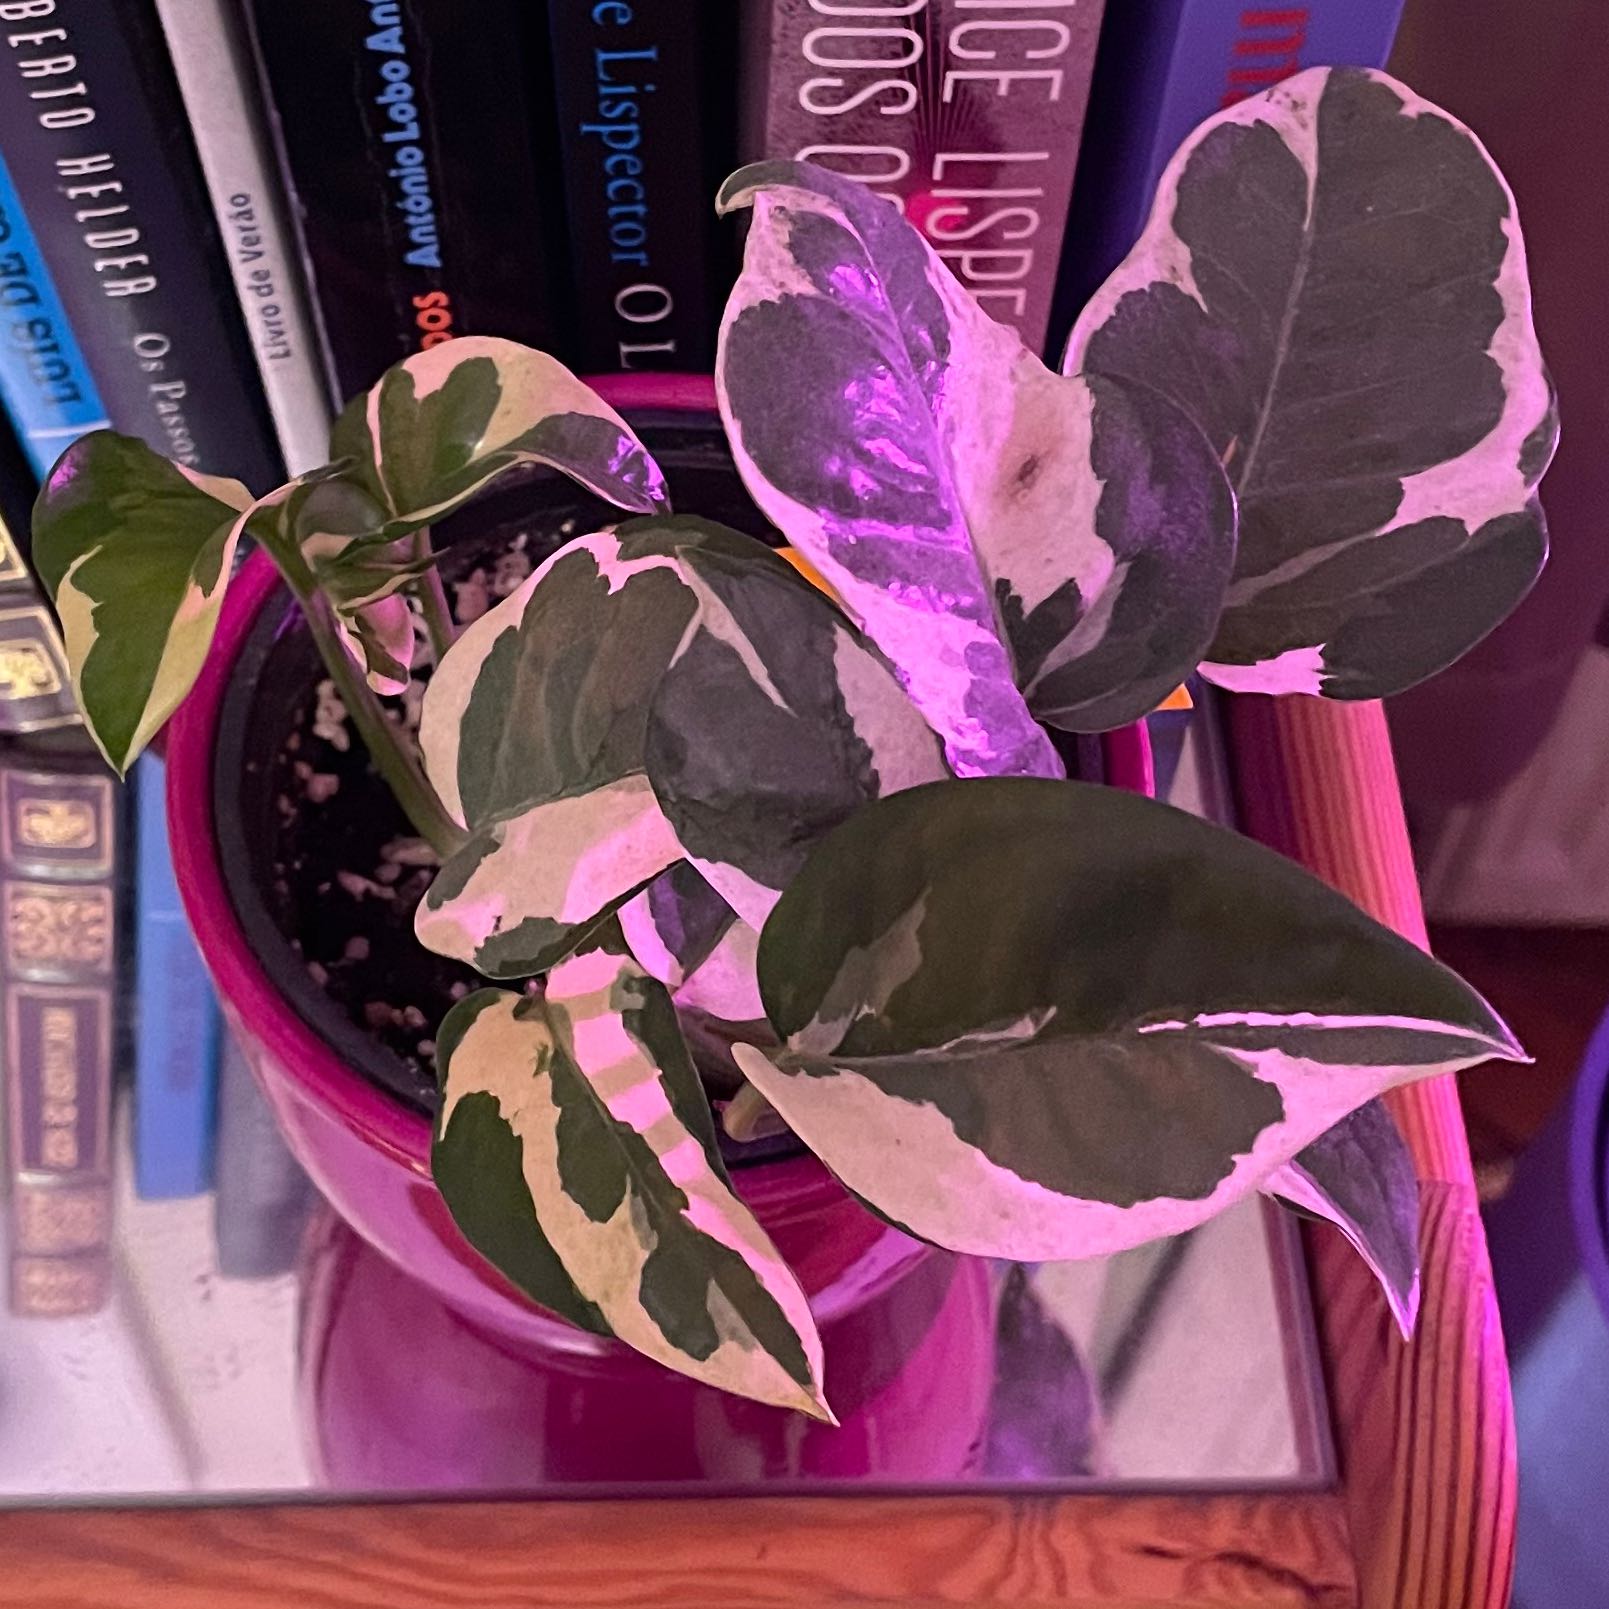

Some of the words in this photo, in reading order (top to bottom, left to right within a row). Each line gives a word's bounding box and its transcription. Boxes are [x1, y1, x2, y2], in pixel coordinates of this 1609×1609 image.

[363, 0, 407, 54] An
[375, 59, 420, 143] Lobo
[580, 46, 659, 267] Lispector
[228, 193, 265, 263] Verão
[388, 146, 443, 269] António
[56, 153, 158, 297] HELDER
[134, 332, 171, 373] Os
[246, 269, 275, 298] de
[262, 303, 293, 361] Livro
[614, 283, 674, 324] O
